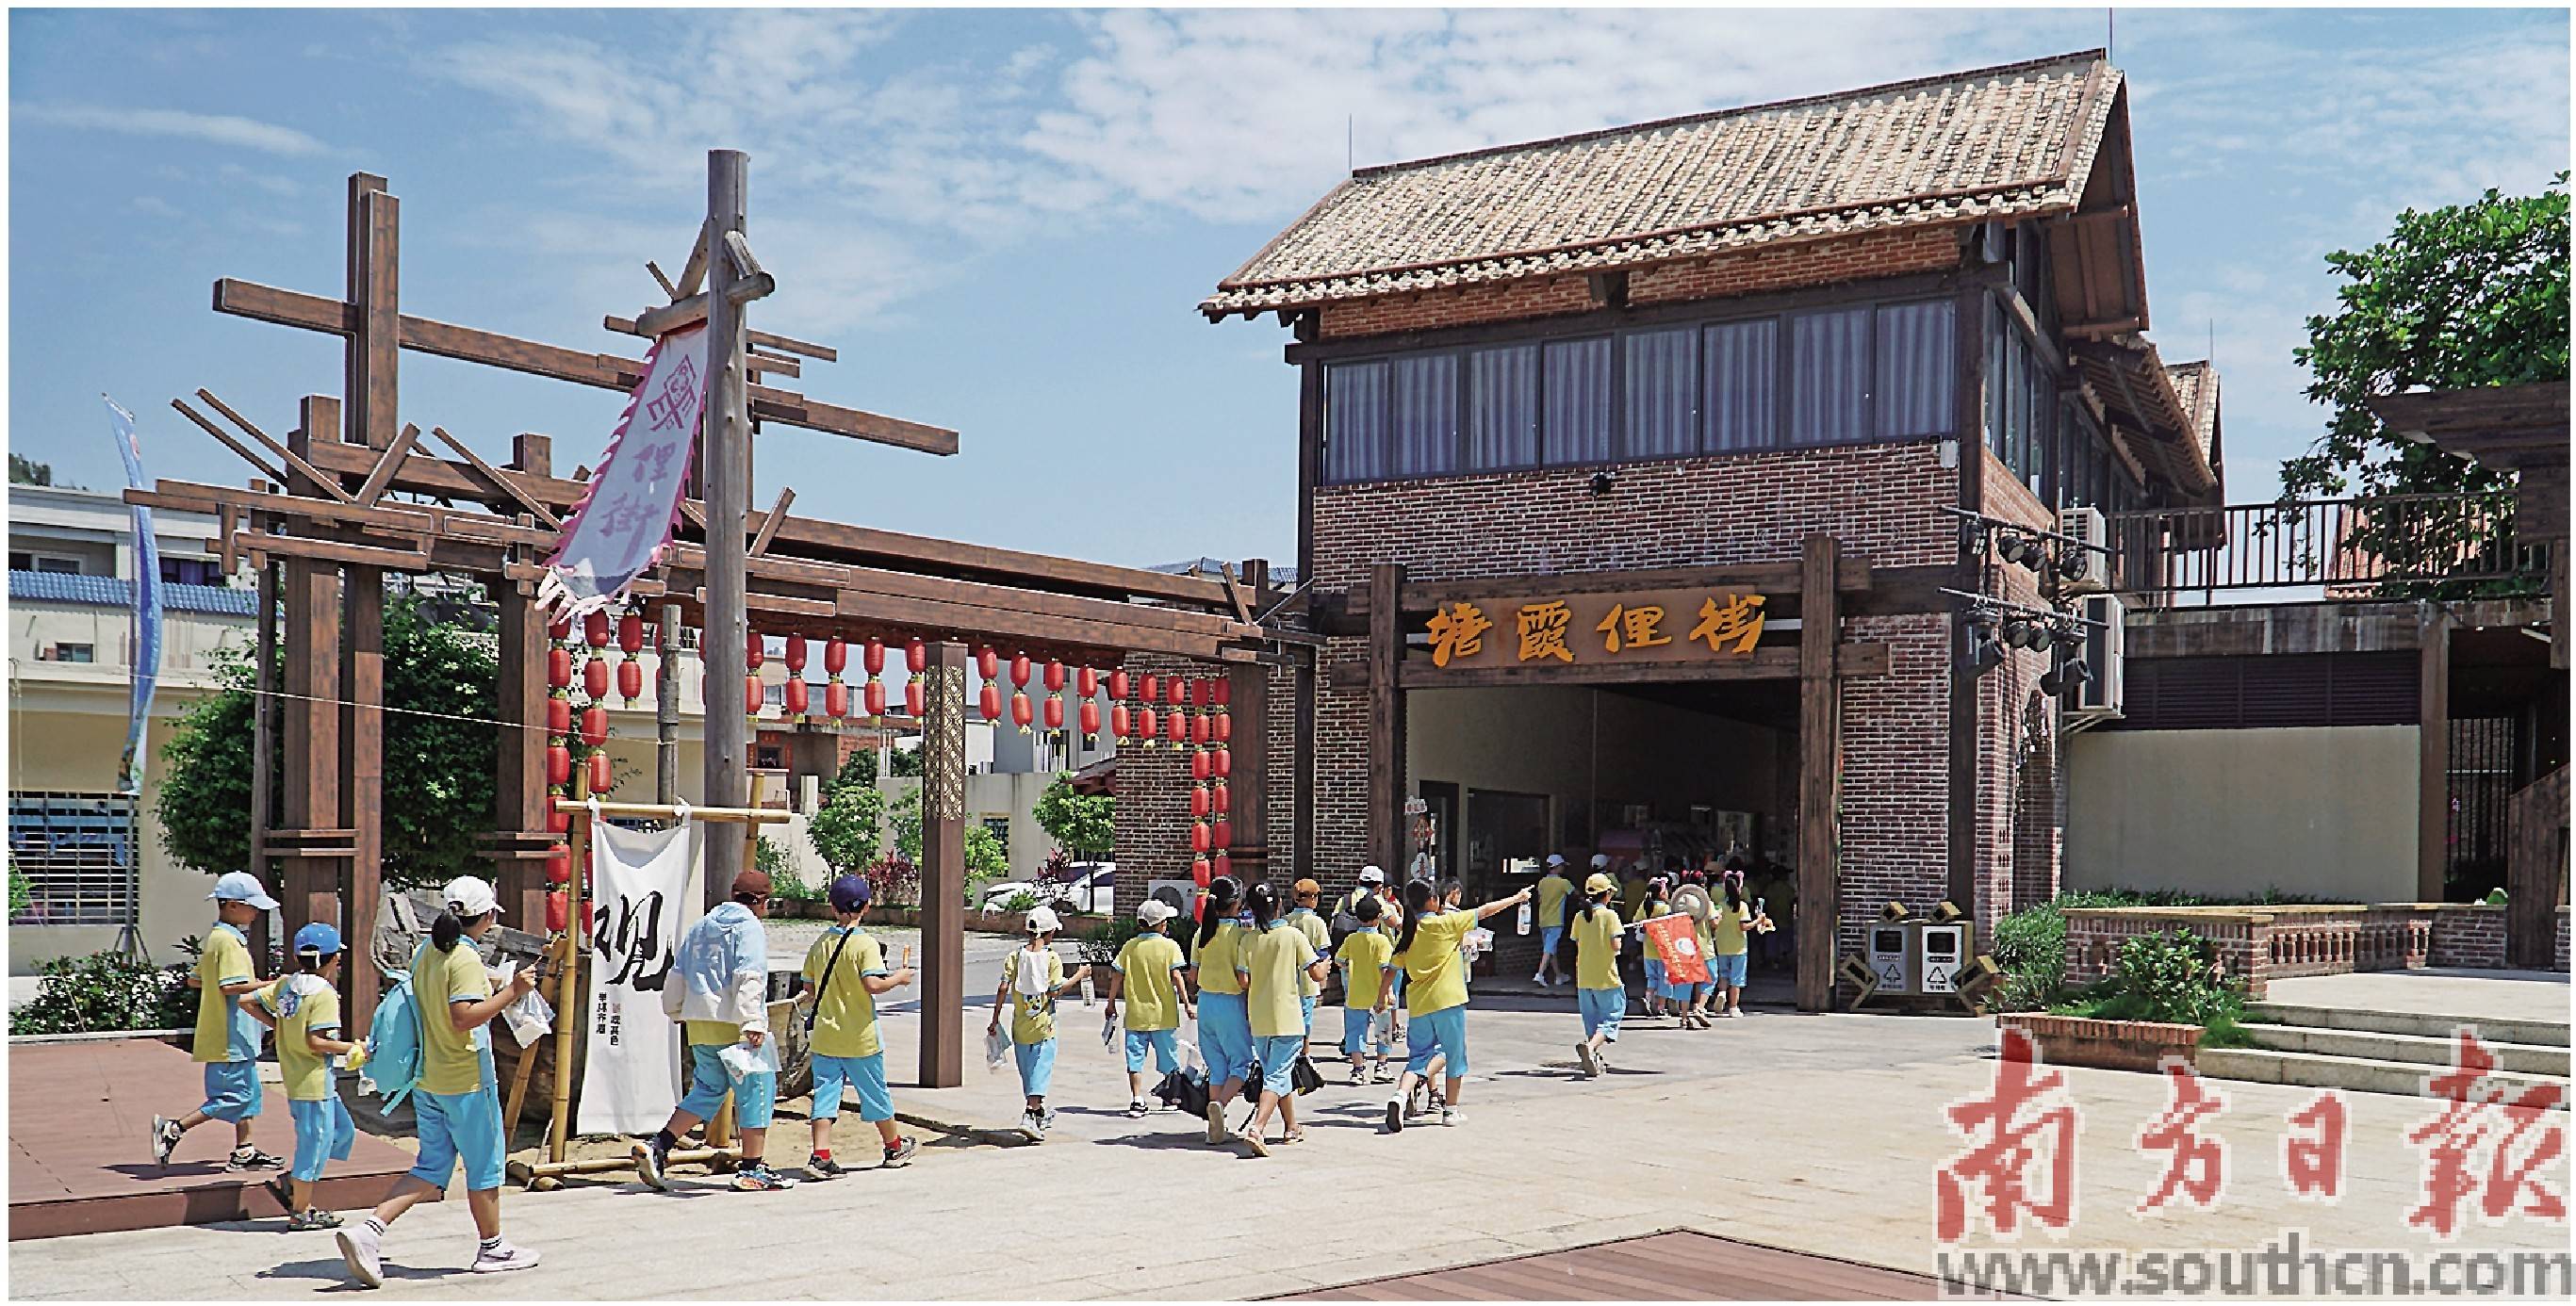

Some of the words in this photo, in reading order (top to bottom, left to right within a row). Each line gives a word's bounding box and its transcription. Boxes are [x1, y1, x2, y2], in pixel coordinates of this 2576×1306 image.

[1425, 594, 1766, 668] 塘霞俚街
[594, 890, 675, 992] 观
